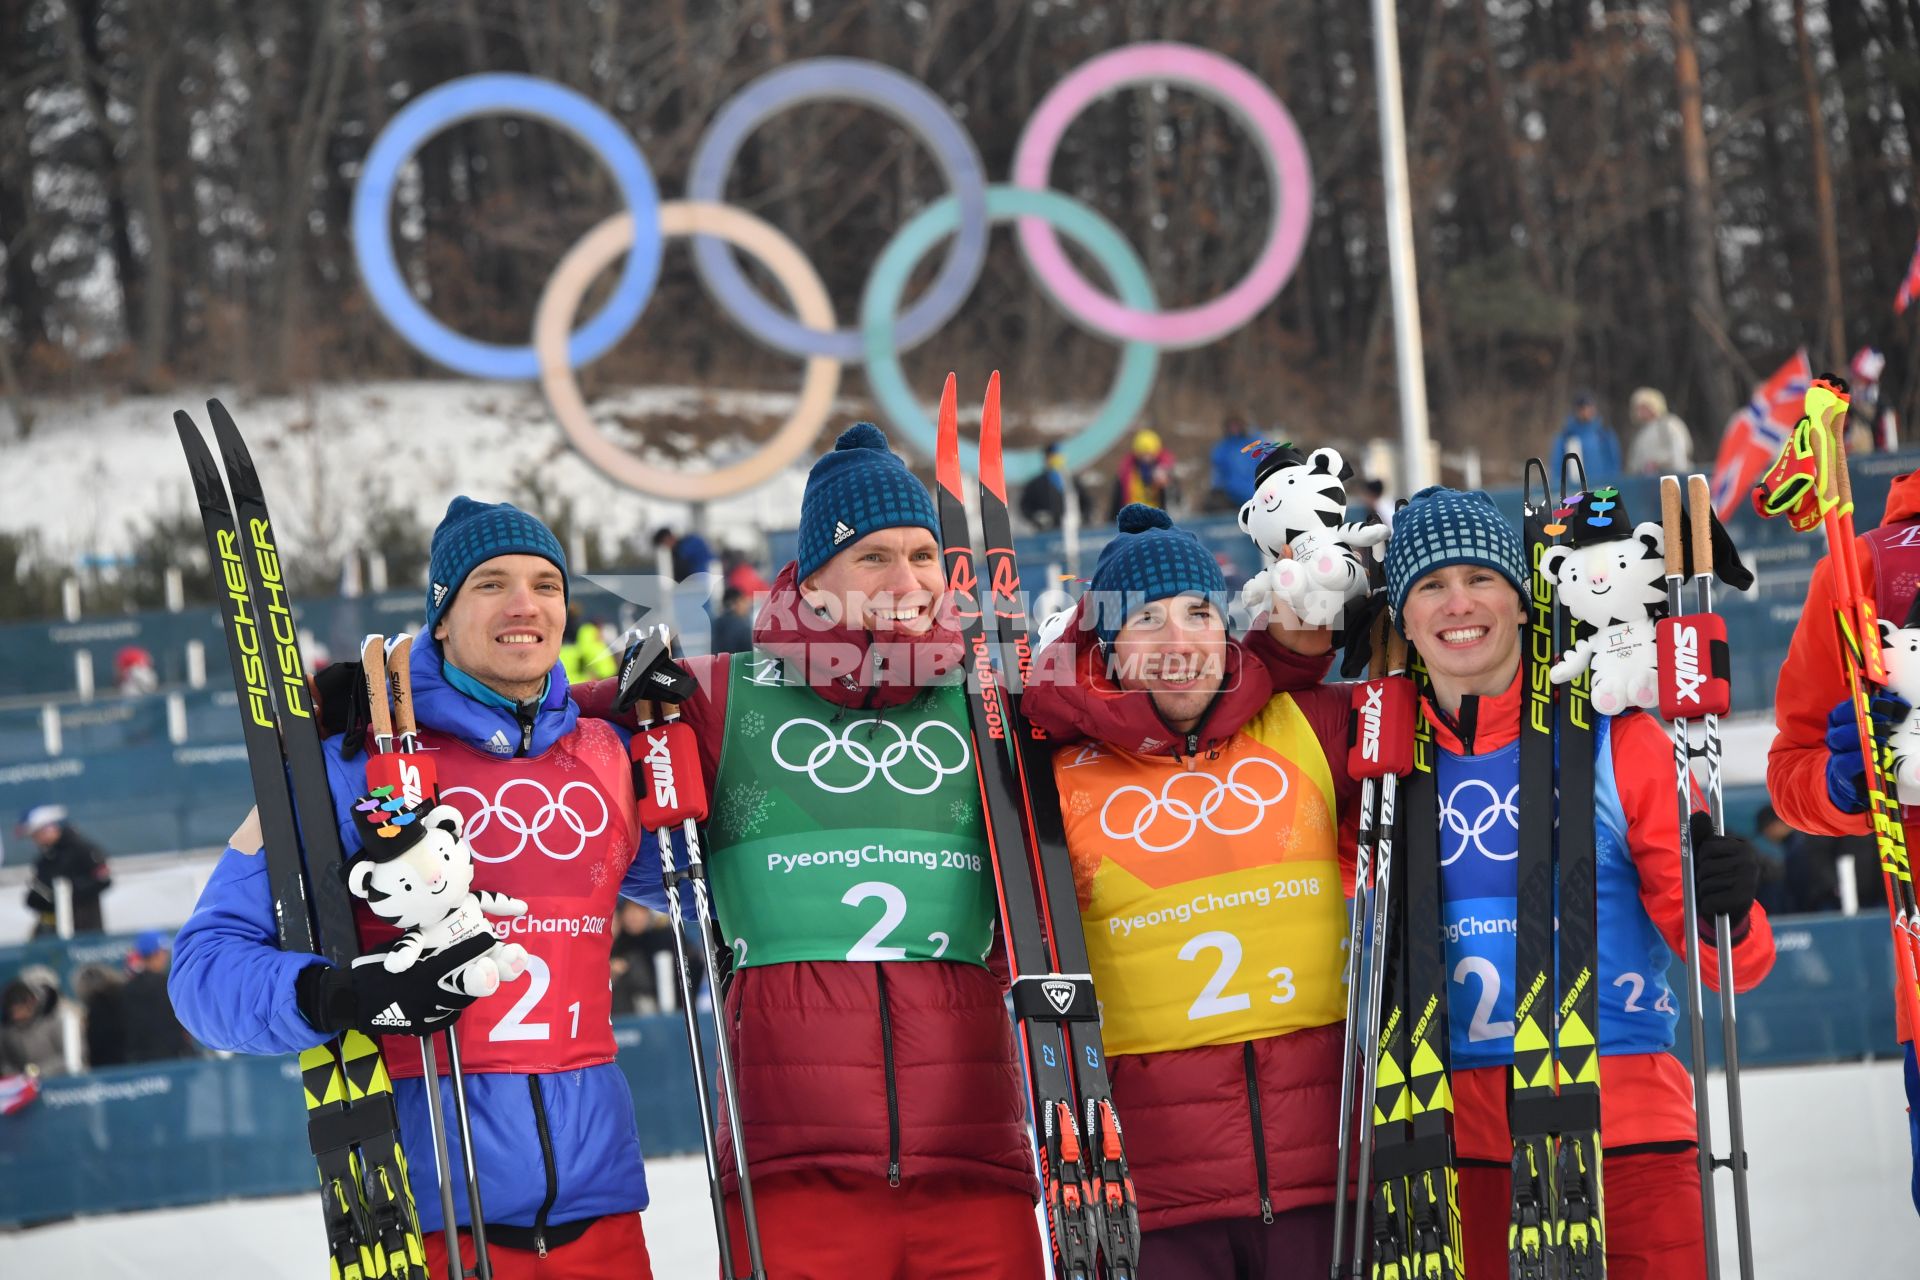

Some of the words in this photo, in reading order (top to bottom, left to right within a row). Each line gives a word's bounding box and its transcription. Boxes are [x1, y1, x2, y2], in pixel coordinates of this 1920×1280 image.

[834, 528, 855, 545] adidas
[216, 529, 273, 728] FISCHER
[250, 518, 310, 718] FISCHER
[972, 632, 1005, 739] ROSSIGNOL
[768, 845, 937, 873] PyeongChang
[941, 850, 982, 872] 2018
[841, 881, 907, 961] 2
[1109, 886, 1271, 936] PyeongChang
[1274, 878, 1321, 902] 2018
[581, 915, 605, 934] 2018
[733, 938, 748, 967] 2
[1177, 931, 1251, 1021] 2
[1267, 966, 1296, 1004] 3
[1532, 970, 1547, 996] MAX
[1576, 966, 1592, 993] MAX
[489, 954, 550, 1040] 2
[568, 1001, 580, 1039] 1
[1424, 993, 1439, 1021] MAX
[1453, 956, 1515, 1043] 2
[1613, 972, 1648, 1013] 2
[371, 1017, 412, 1027] adidas
[1387, 1004, 1402, 1032] MAX
